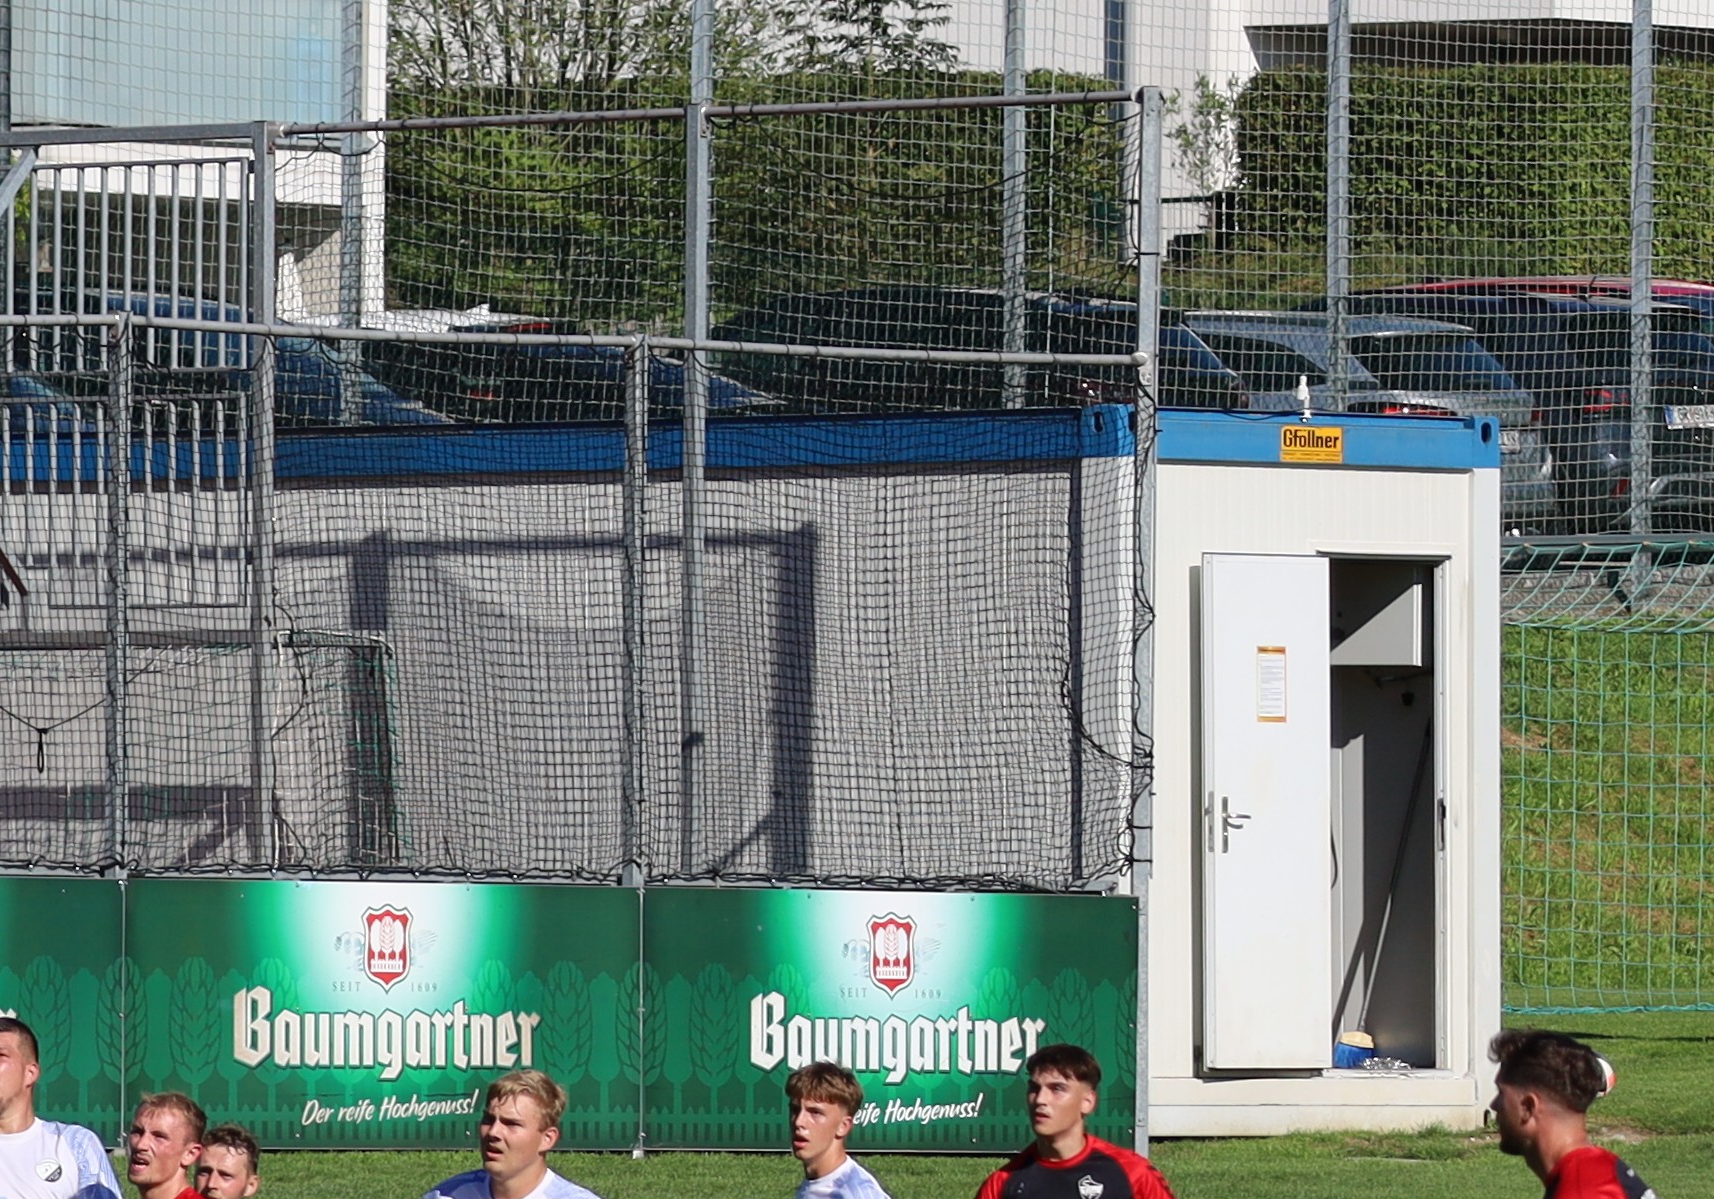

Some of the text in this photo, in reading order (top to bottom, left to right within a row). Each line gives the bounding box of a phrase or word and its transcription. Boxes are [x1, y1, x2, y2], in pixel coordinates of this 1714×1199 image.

[332, 980, 438, 993] SEIT 1609
[839, 986, 942, 1000] SEIT 1609
[233, 985, 541, 1082] Baumgartner
[750, 991, 1046, 1085] Baumgartner
[301, 1088, 478, 1126] Der reife Hochgenuss!
[854, 1092, 984, 1127] eife Hochgenuss!
